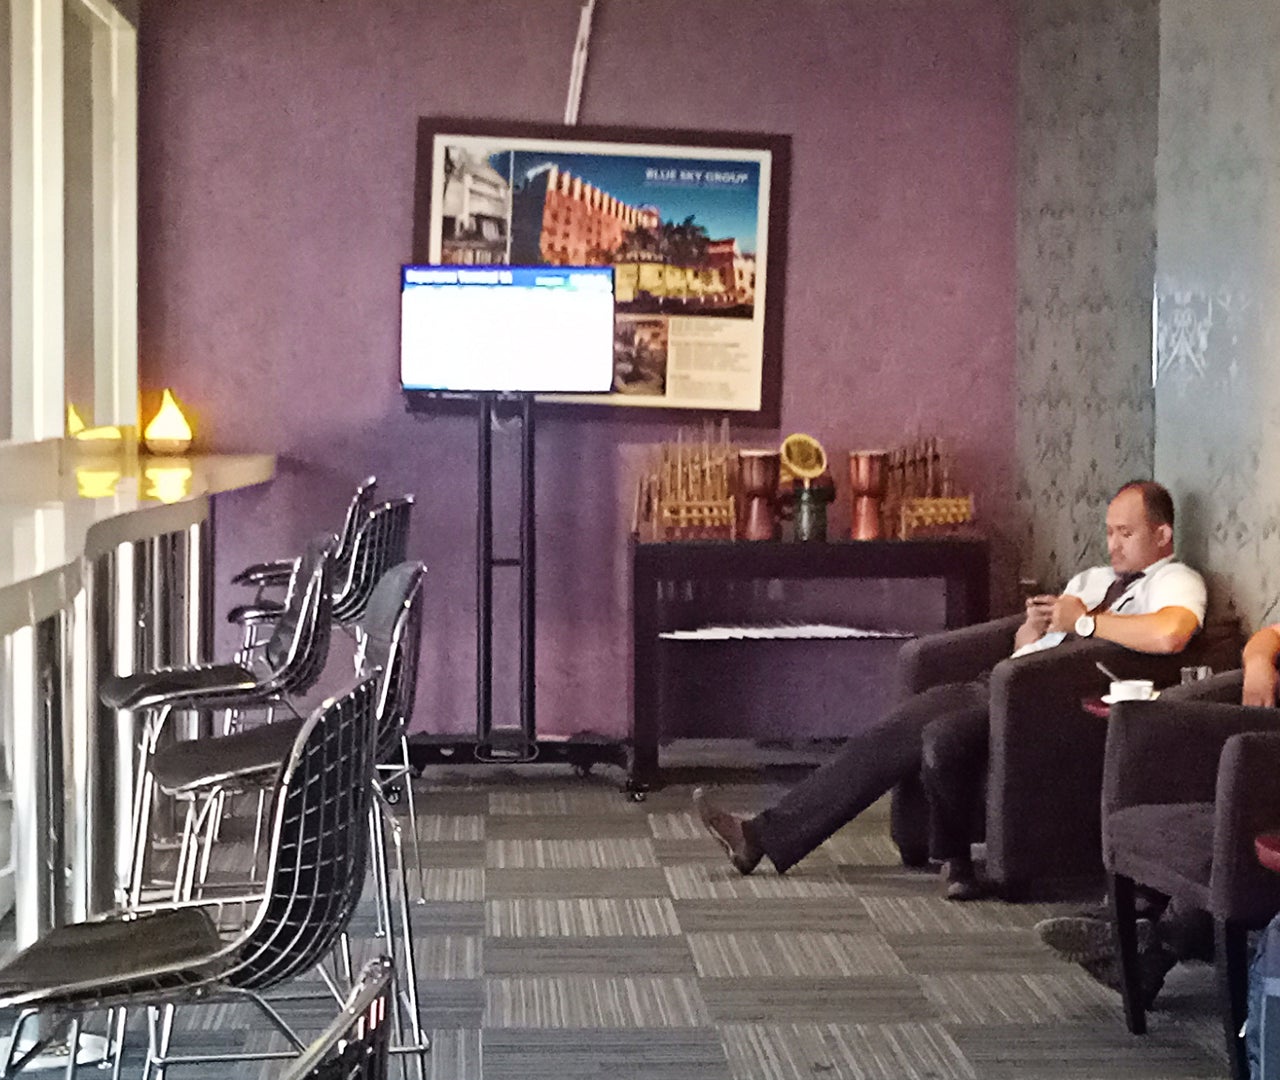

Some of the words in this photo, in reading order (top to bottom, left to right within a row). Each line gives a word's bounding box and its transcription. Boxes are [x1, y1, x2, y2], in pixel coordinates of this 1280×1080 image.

[646, 168, 677, 180] BLUE
[680, 169, 703, 181] SKY
[706, 171, 749, 183] GROUP
